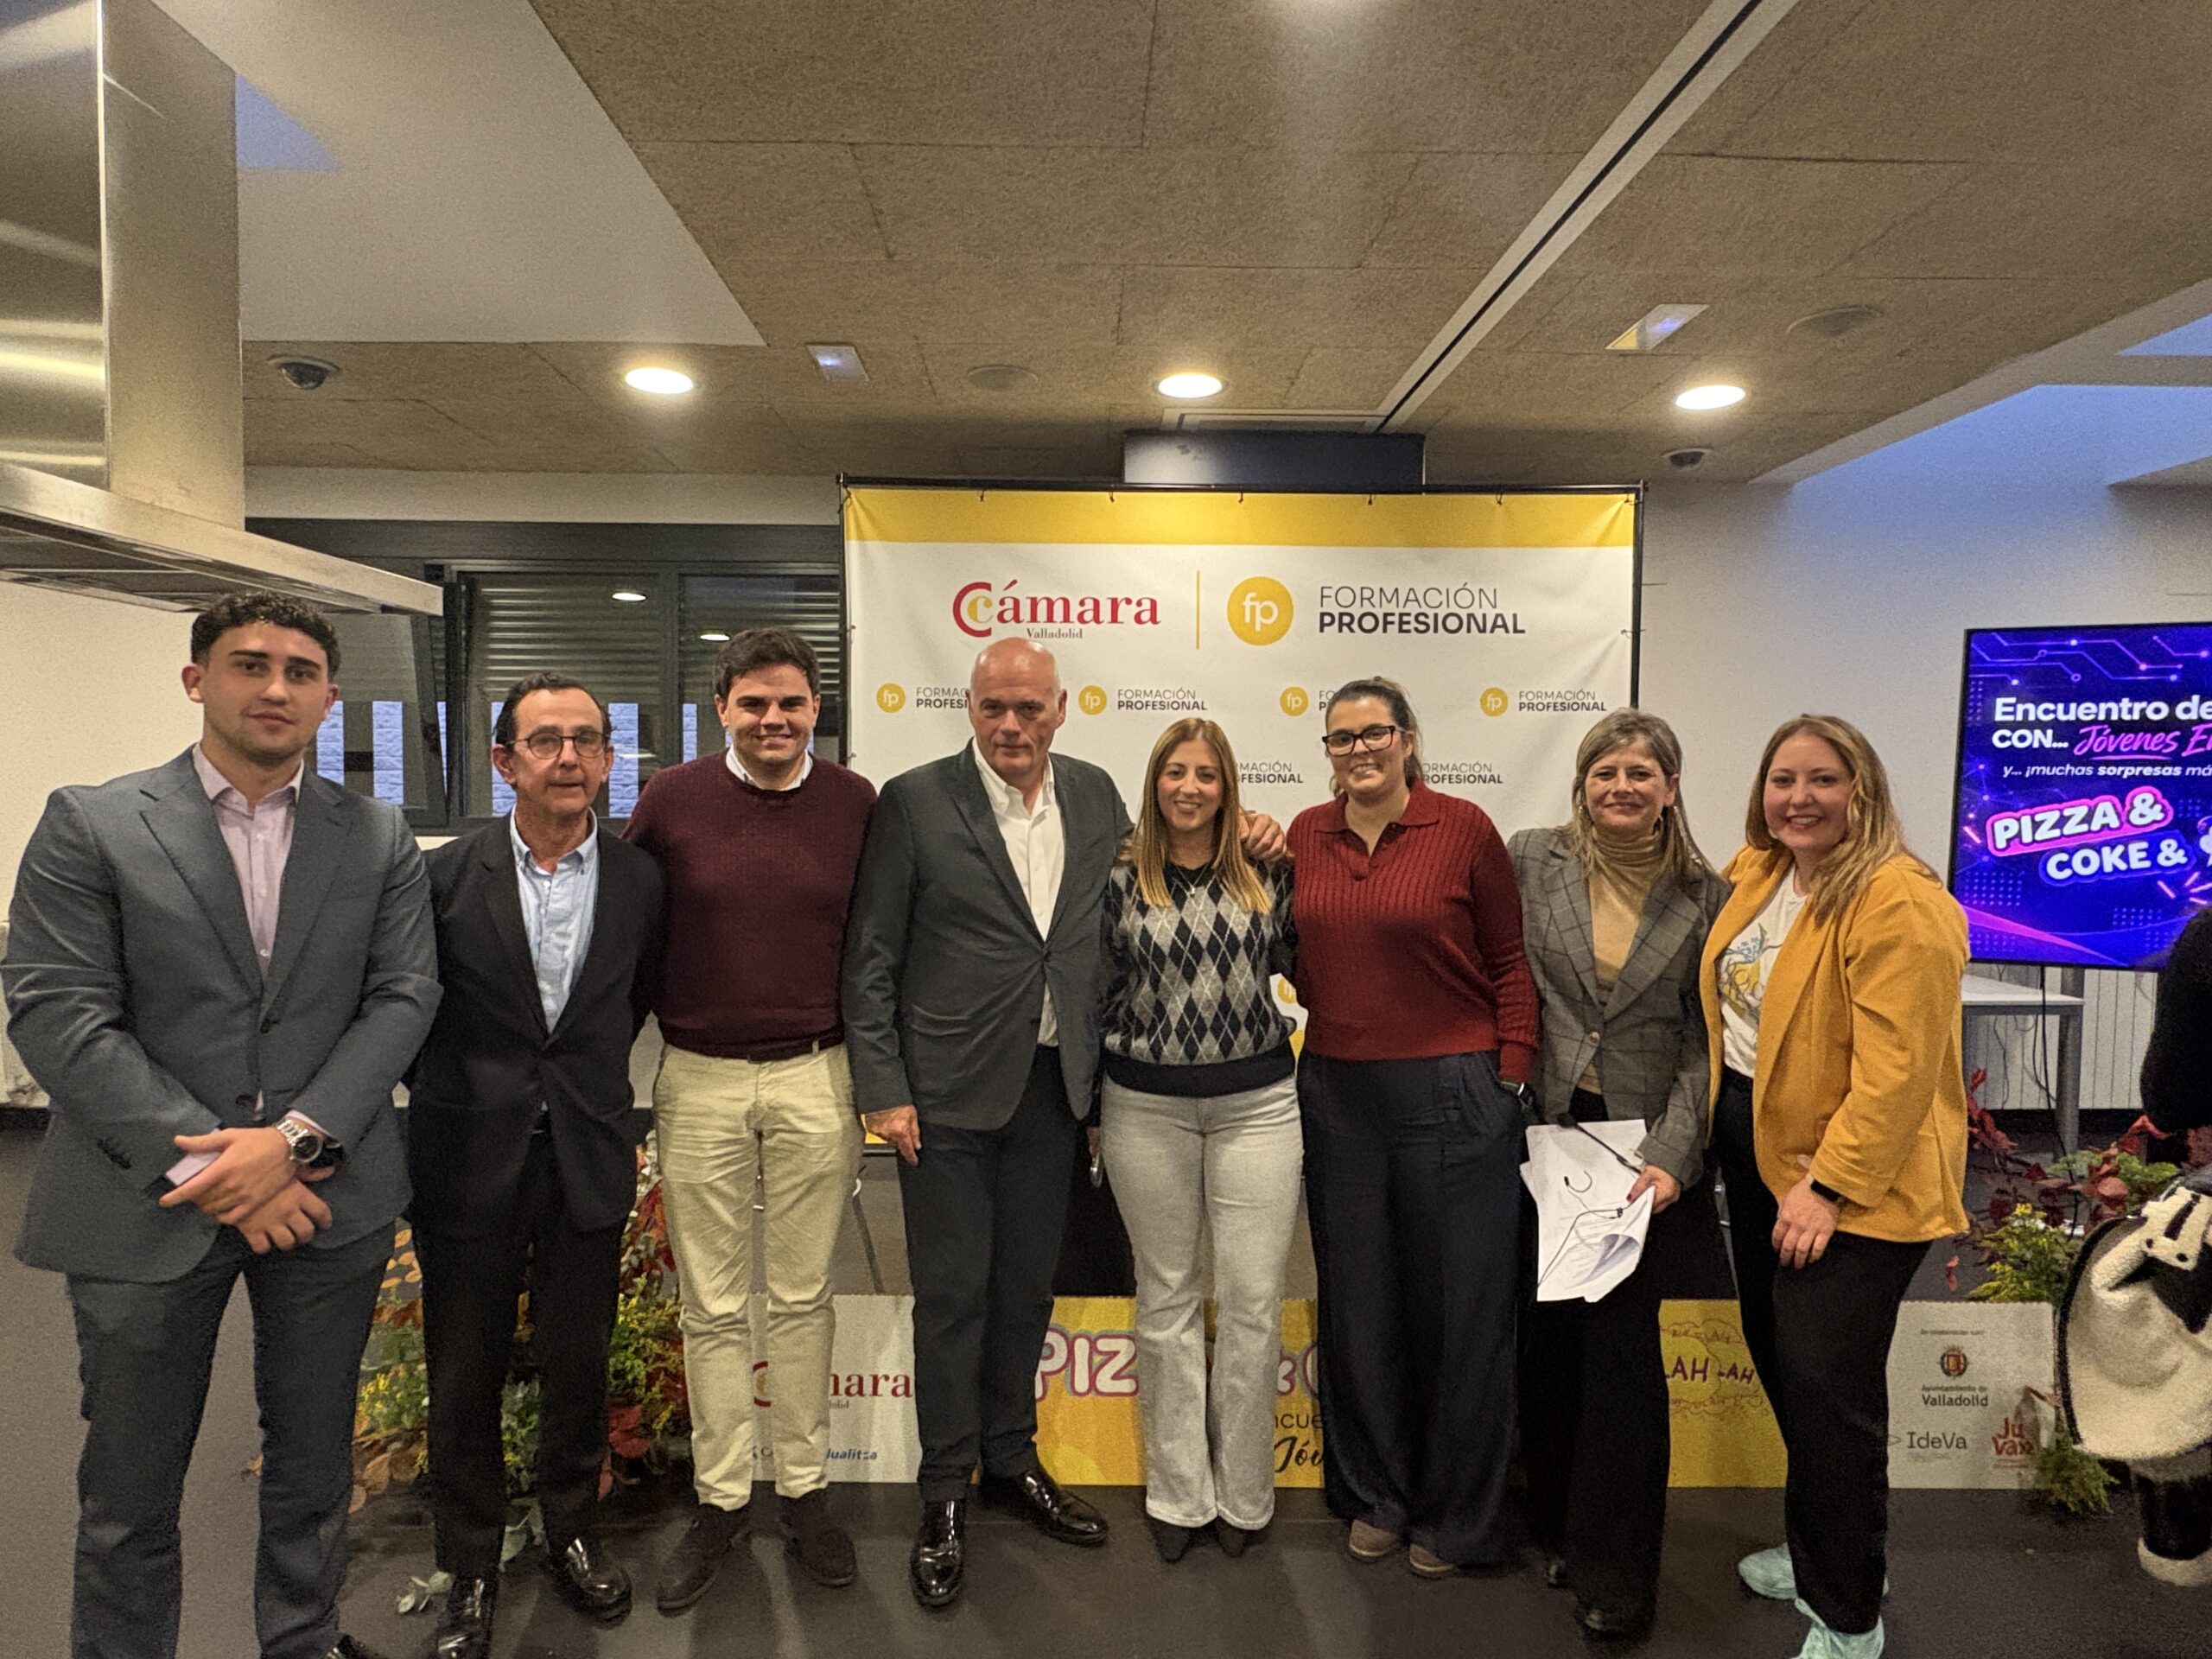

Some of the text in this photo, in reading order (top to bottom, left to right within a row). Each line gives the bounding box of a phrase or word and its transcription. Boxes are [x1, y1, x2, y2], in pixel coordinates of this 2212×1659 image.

[1319, 582, 1497, 609] FORMACIÓN
[1243, 592, 1279, 632] fp
[1319, 611, 1526, 634] PROFESIONAL
[1027, 627, 1084, 639] Valladolid
[1117, 687, 1197, 700] FORMACIÓN
[1519, 688, 1596, 702] FORMACIÓN
[1117, 700, 1208, 710] PROFESIONAL
[1519, 702, 1607, 712] PROFESIONAL
[1994, 696, 2170, 722] Encuentro
[1992, 728, 2069, 749] CON...
[2074, 725, 2181, 756] Jóvenes
[1236, 760, 1293, 772] MACIÓN
[2025, 764, 2093, 777] ¡muchas
[2097, 765, 2182, 779] sorpresas
[1237, 773, 1303, 784] FESIONAL
[1993, 792, 2165, 849] PIZZA &
[2046, 838, 2189, 880] COKE &
[1922, 1394, 1988, 1408] Valladolid
[1906, 1431, 1967, 1449] IdeVa
